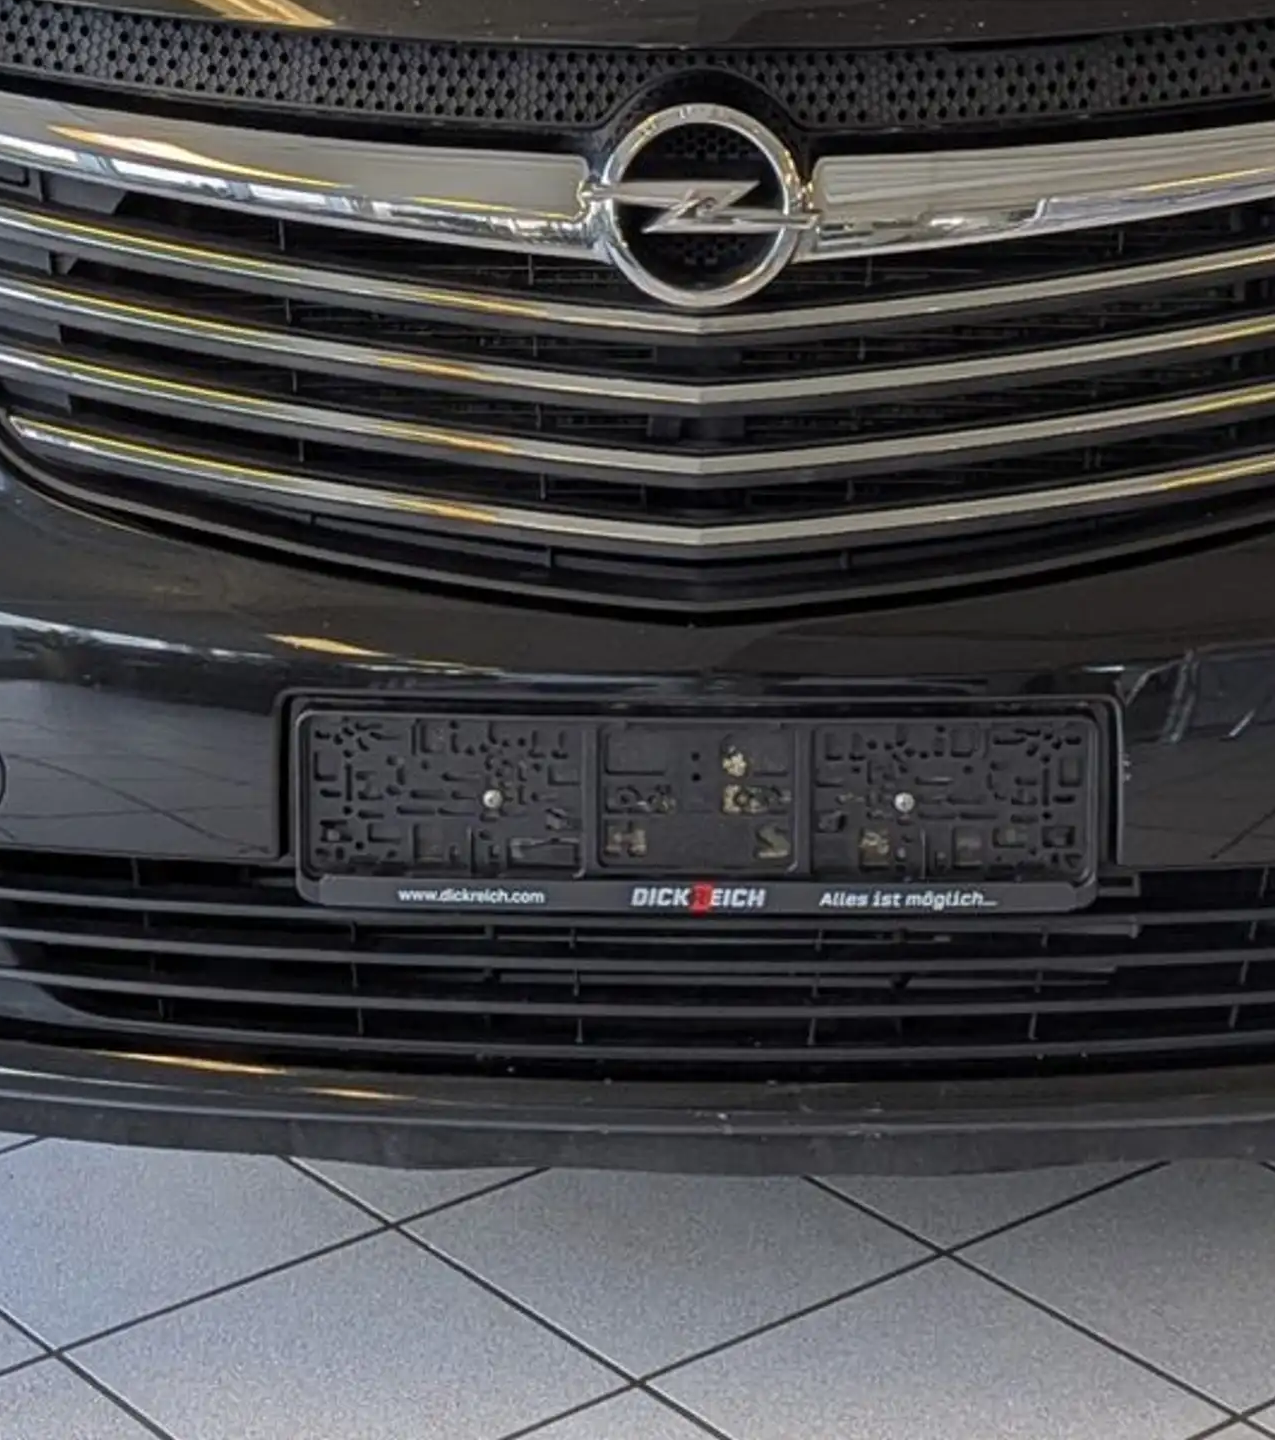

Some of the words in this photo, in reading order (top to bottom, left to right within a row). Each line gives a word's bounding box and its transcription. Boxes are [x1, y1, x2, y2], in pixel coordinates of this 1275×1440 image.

[397, 888, 545, 904] www.dickreich.com
[818, 891, 869, 907] Alles
[872, 891, 903, 907] ist
